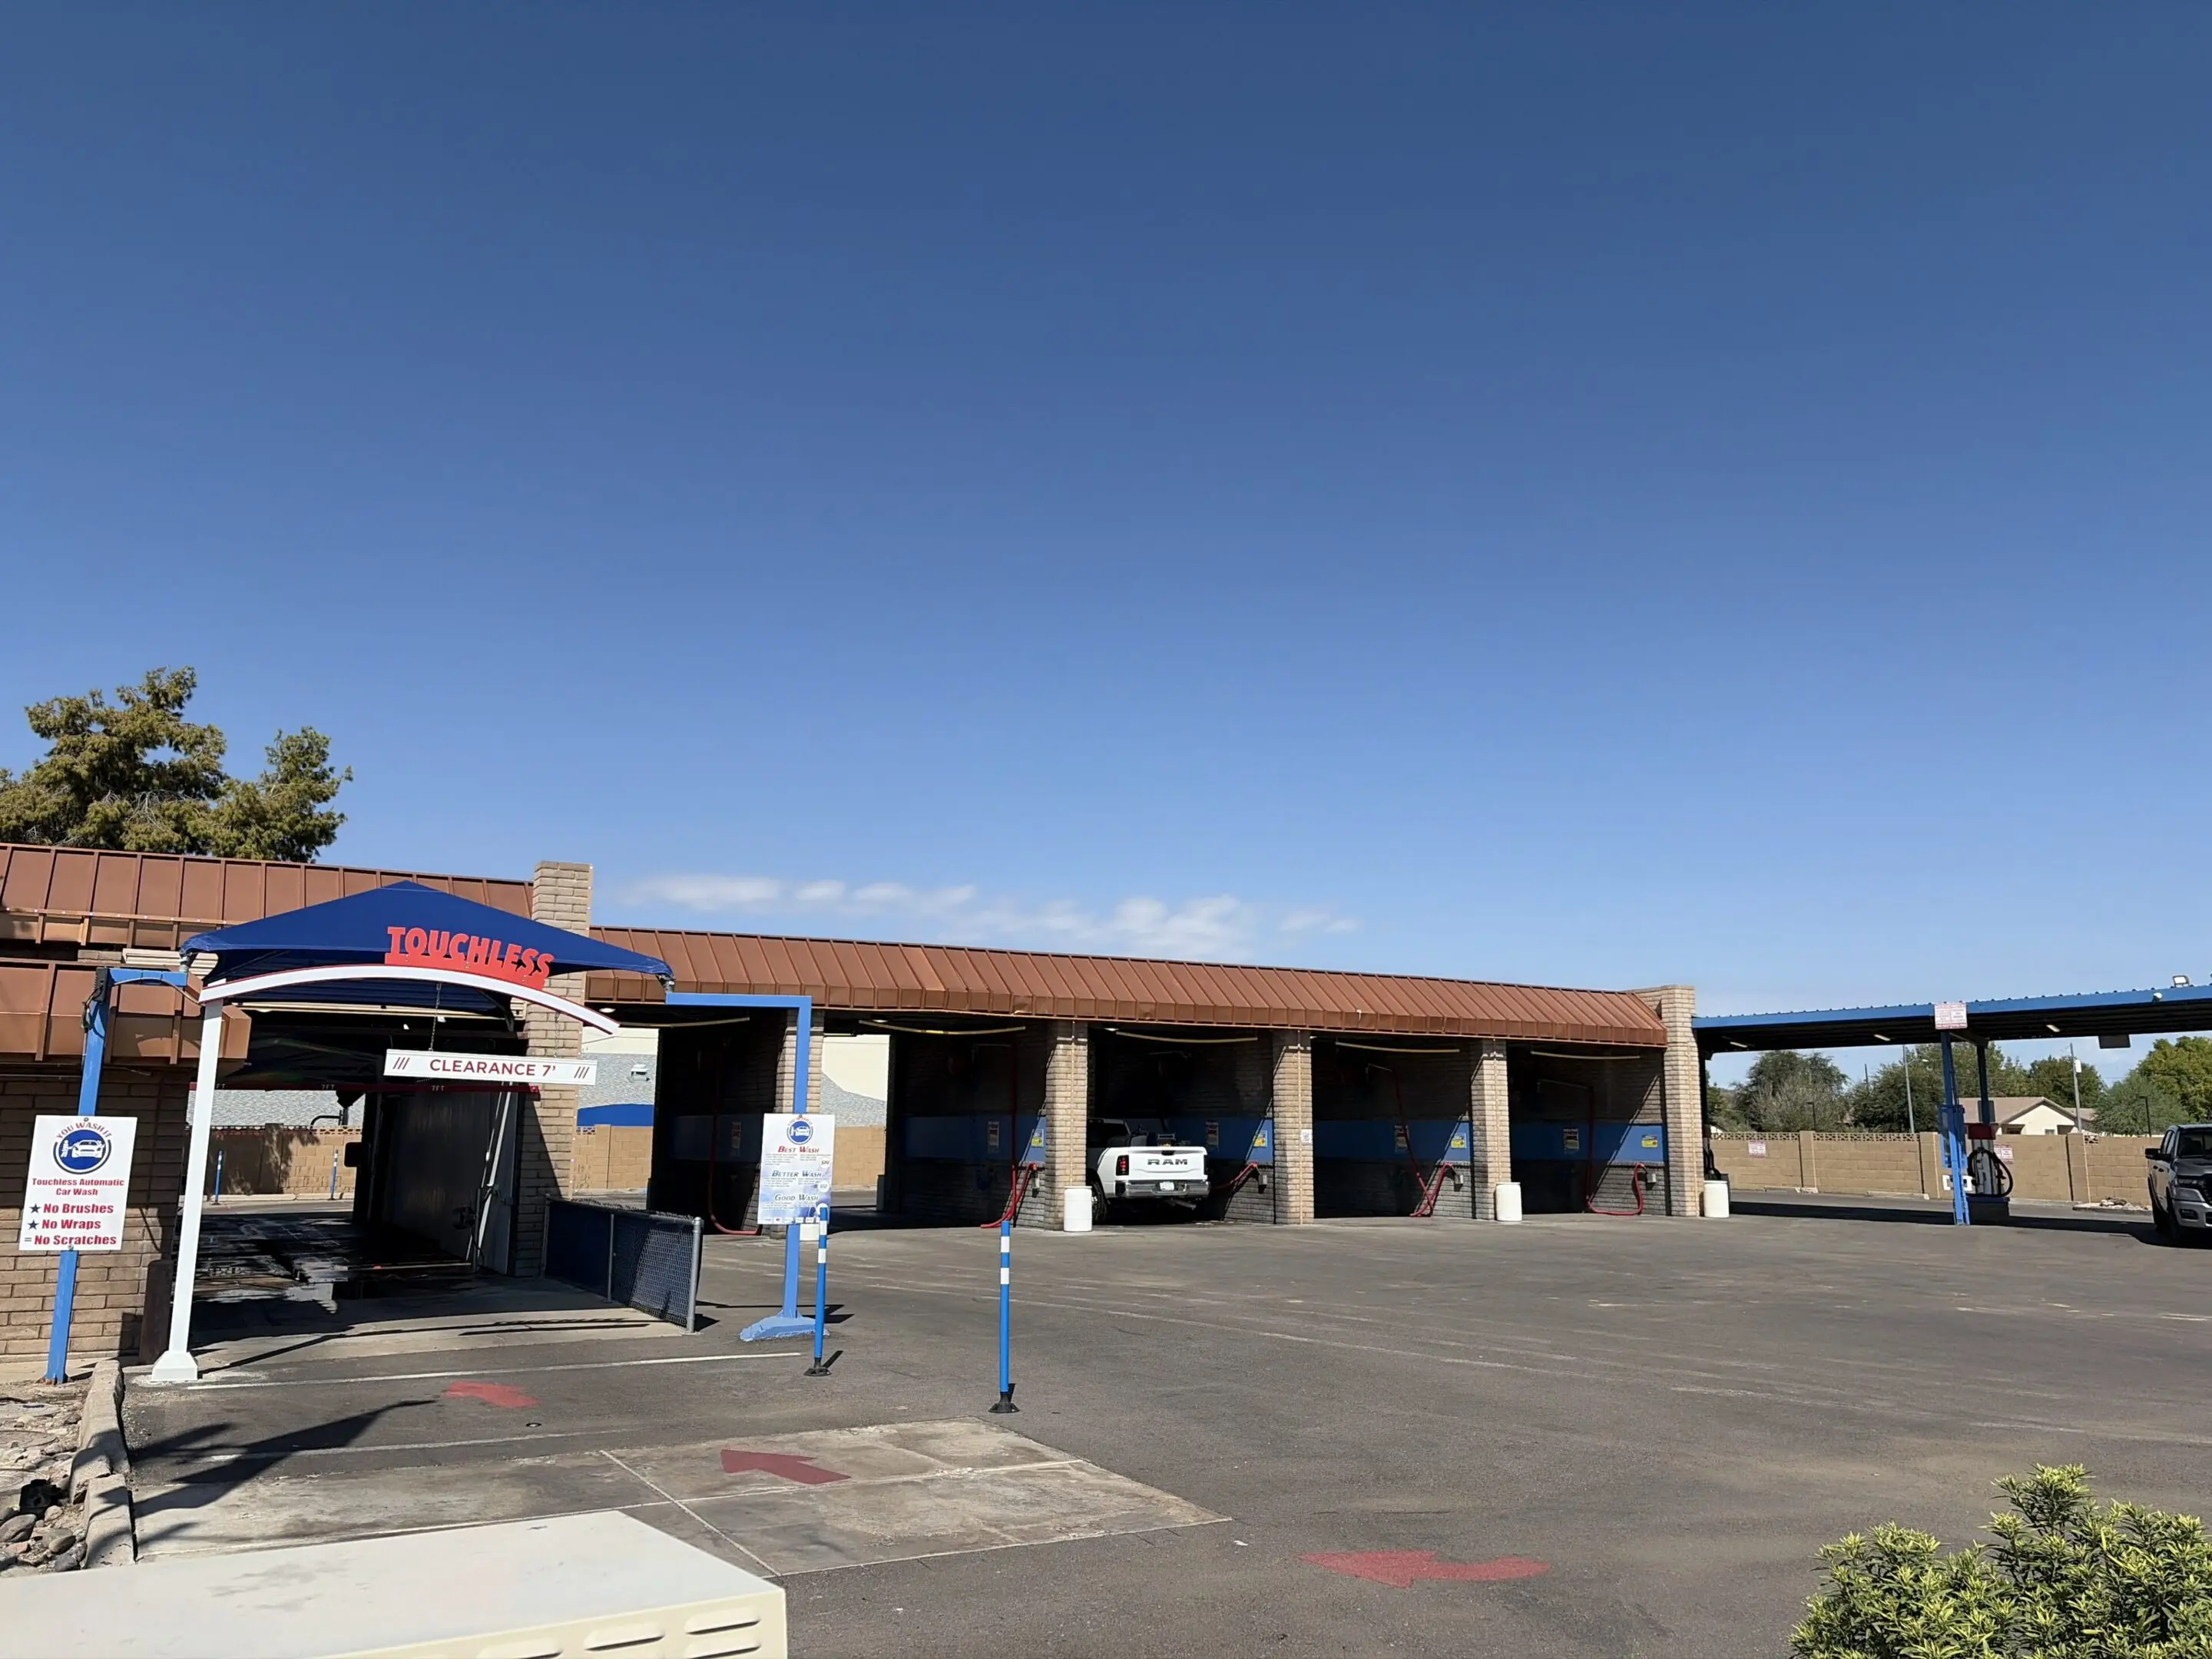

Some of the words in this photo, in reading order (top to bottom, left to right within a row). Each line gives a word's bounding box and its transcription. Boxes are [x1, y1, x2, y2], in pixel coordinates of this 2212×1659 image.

[387, 926, 555, 982] TOUCHLESS
[429, 1058, 536, 1076] CLEARANCE
[56, 1124, 75, 1138] YOU
[75, 1122, 105, 1133] WASH
[43, 1203, 59, 1214] No
[62, 1203, 114, 1214] Brushes
[41, 1219, 58, 1229] No
[61, 1219, 101, 1230] Wraps
[34, 1235, 50, 1245] No
[53, 1234, 117, 1245] Scratches
